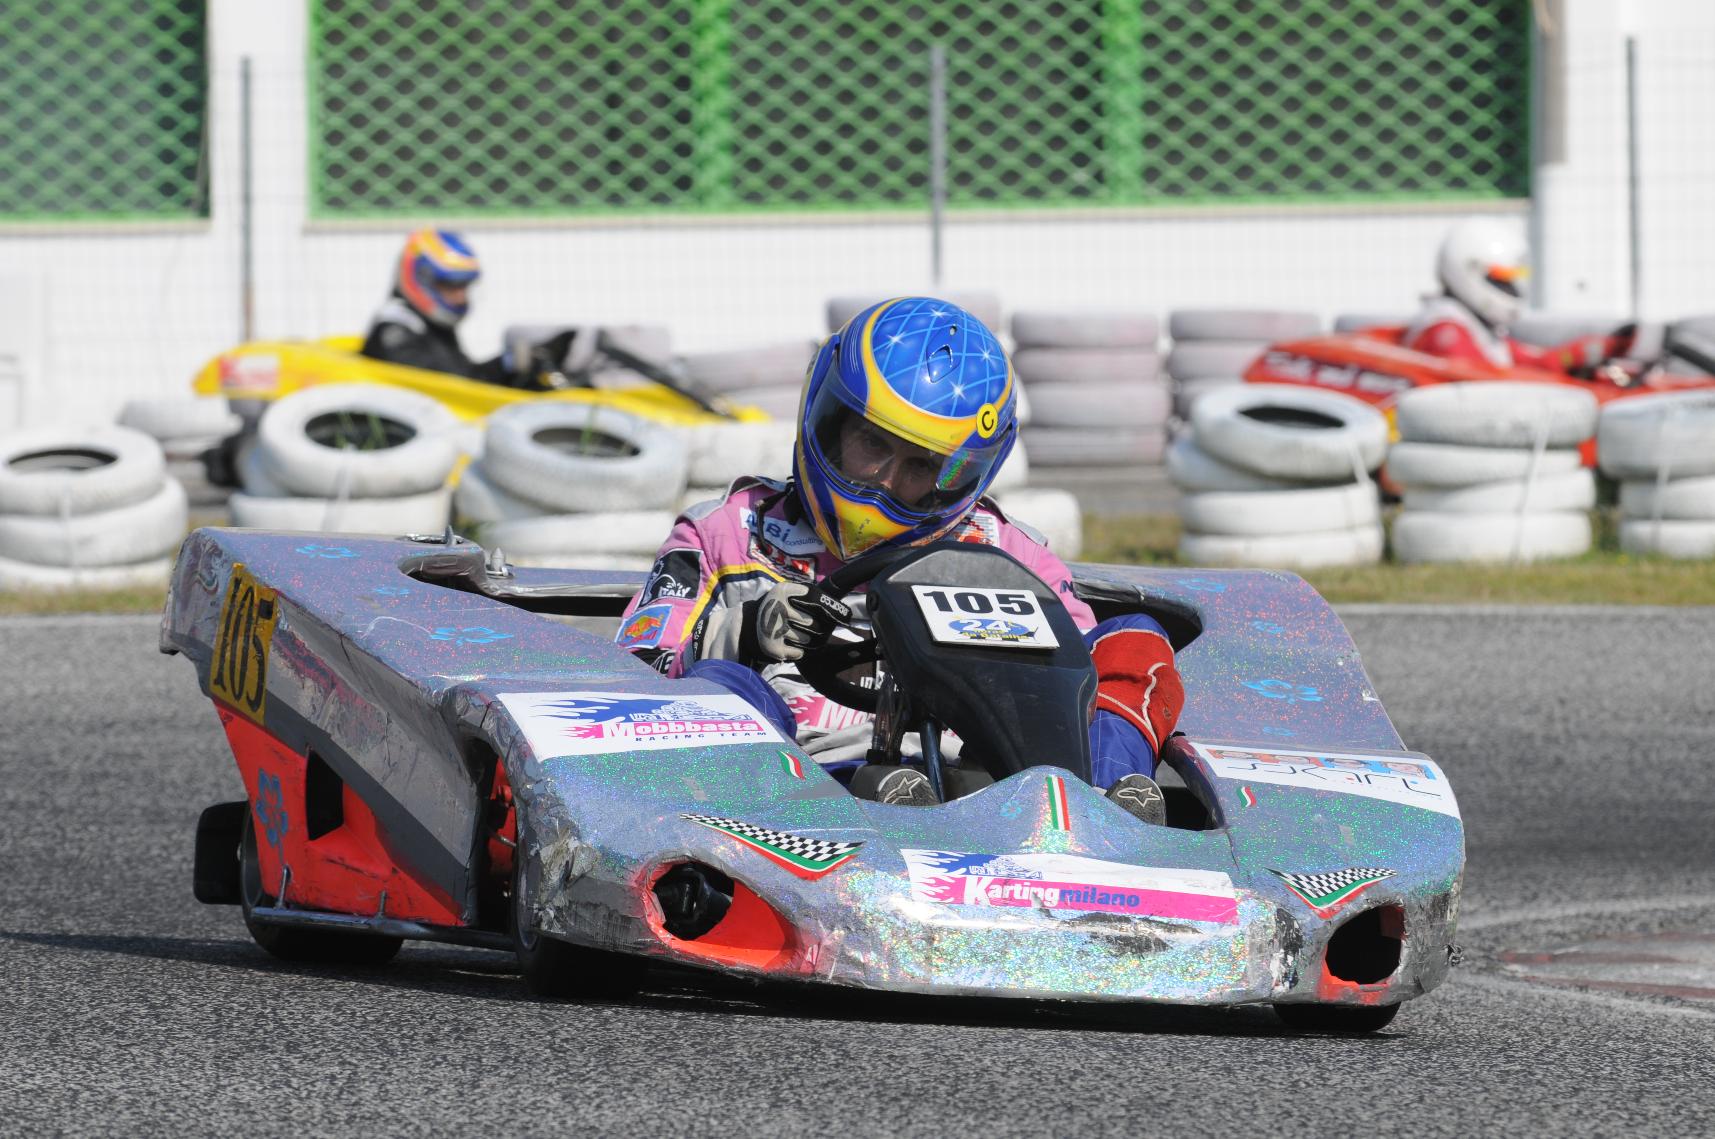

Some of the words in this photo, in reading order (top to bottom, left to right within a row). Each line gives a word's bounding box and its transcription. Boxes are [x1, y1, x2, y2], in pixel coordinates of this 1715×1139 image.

[922, 590, 1035, 616] 105
[959, 619, 1011, 632] 24
[214, 578, 273, 713] 105
[601, 720, 760, 739] Mobbbasta
[635, 733, 705, 742] RACING
